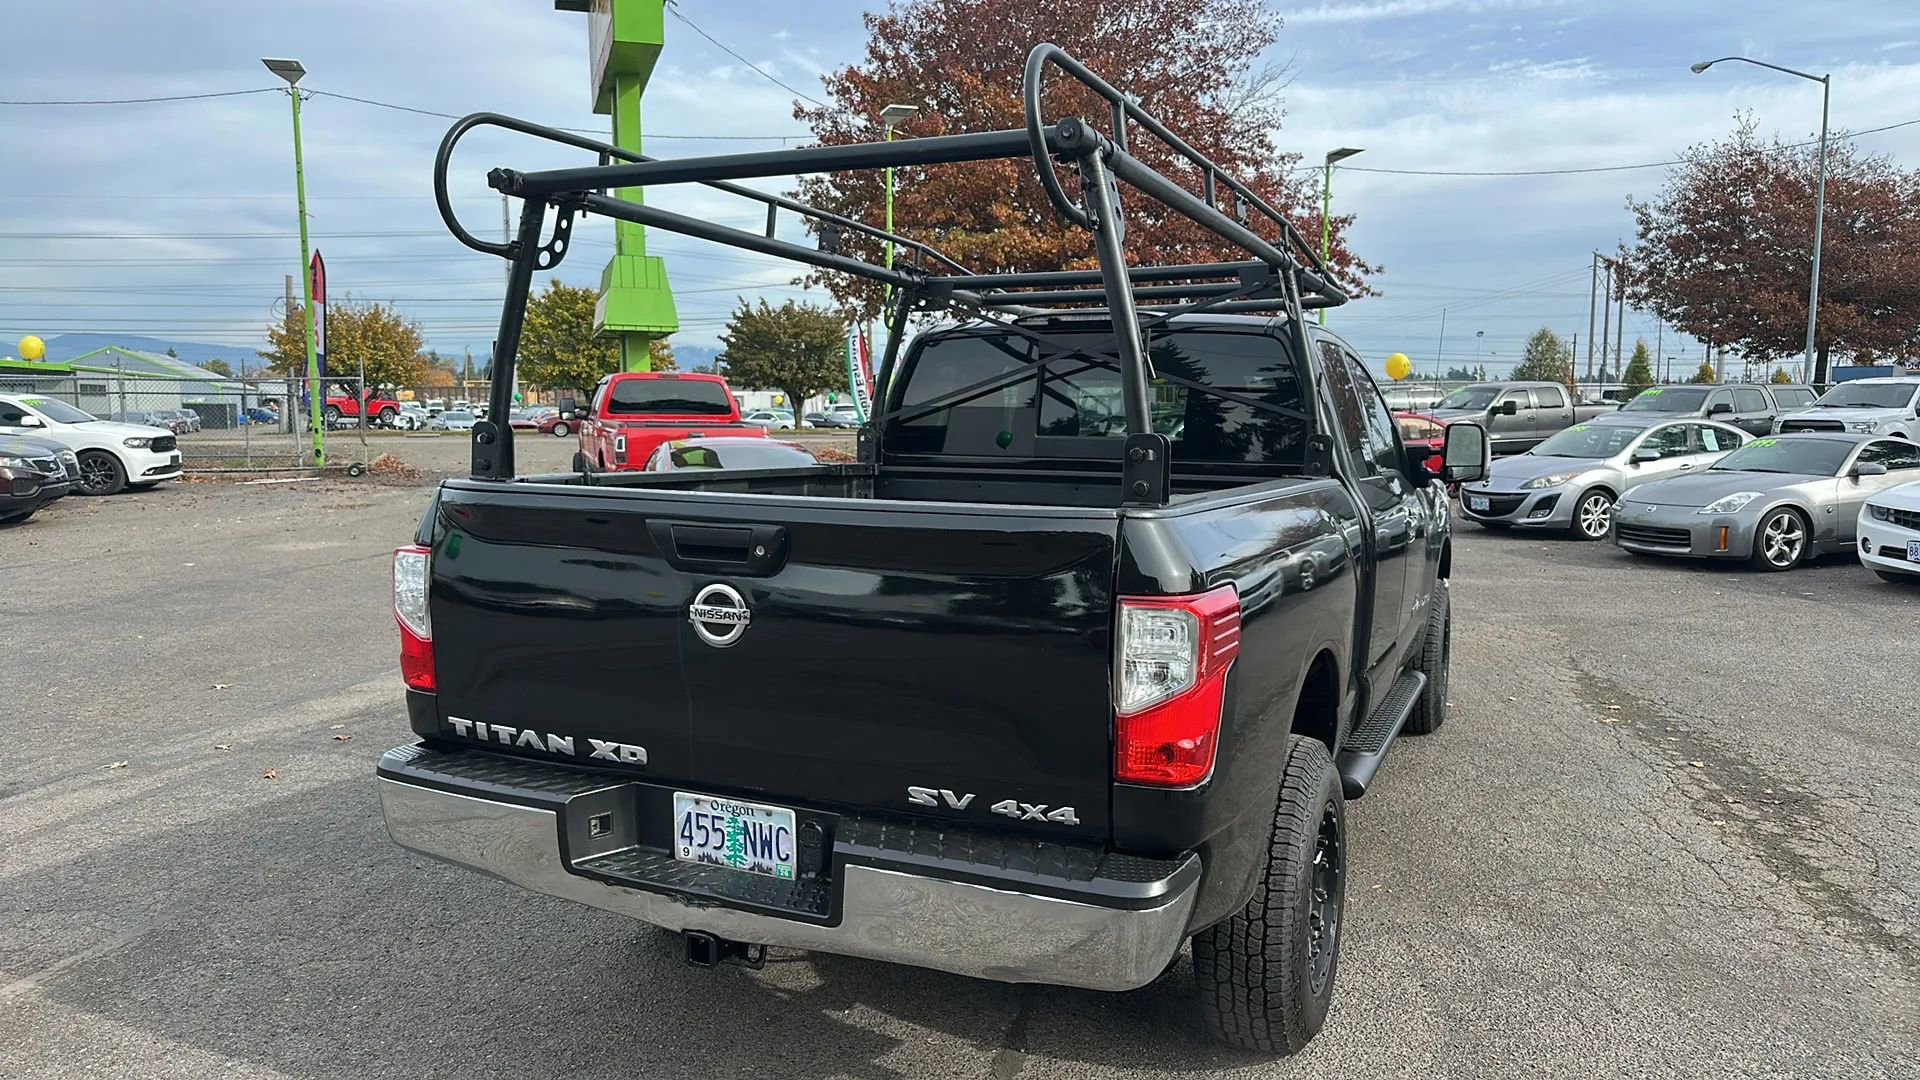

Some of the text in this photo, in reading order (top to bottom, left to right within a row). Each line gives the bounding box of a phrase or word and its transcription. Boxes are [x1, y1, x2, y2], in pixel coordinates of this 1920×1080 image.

[694, 608, 741, 621] NISSAN
[447, 715, 649, 766] TITAN XD
[710, 799, 755, 818] Oregon
[907, 786, 1081, 827] SV 4x4
[680, 811, 790, 862] 455 NWC
[682, 846, 690, 857] 9
